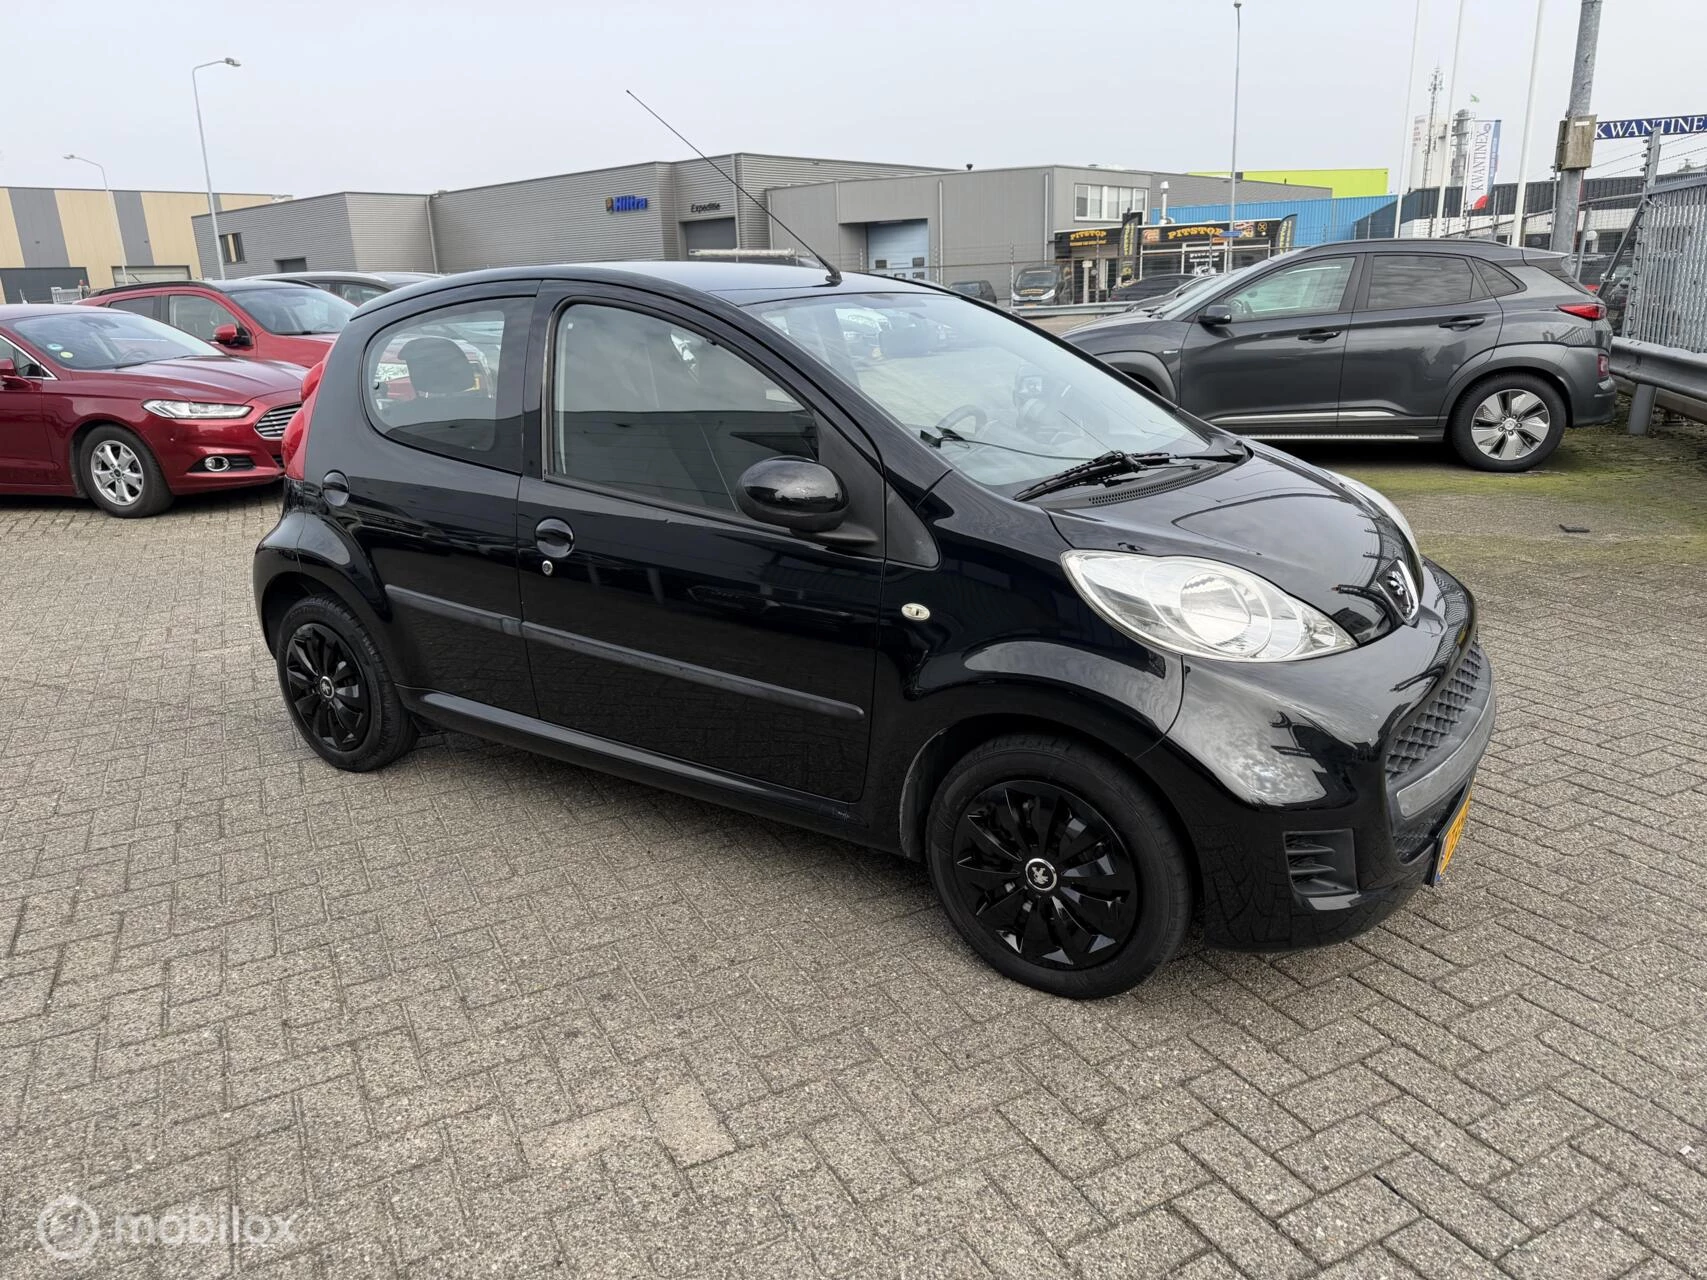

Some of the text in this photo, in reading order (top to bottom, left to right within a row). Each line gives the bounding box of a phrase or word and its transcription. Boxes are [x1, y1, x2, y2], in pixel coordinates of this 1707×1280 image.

[1595, 116, 1707, 138] KWANTINE
[1471, 130, 1490, 191] KWANTINEX
[1070, 230, 1106, 240] PITSTOP
[1168, 226, 1224, 239] PITSTOP
